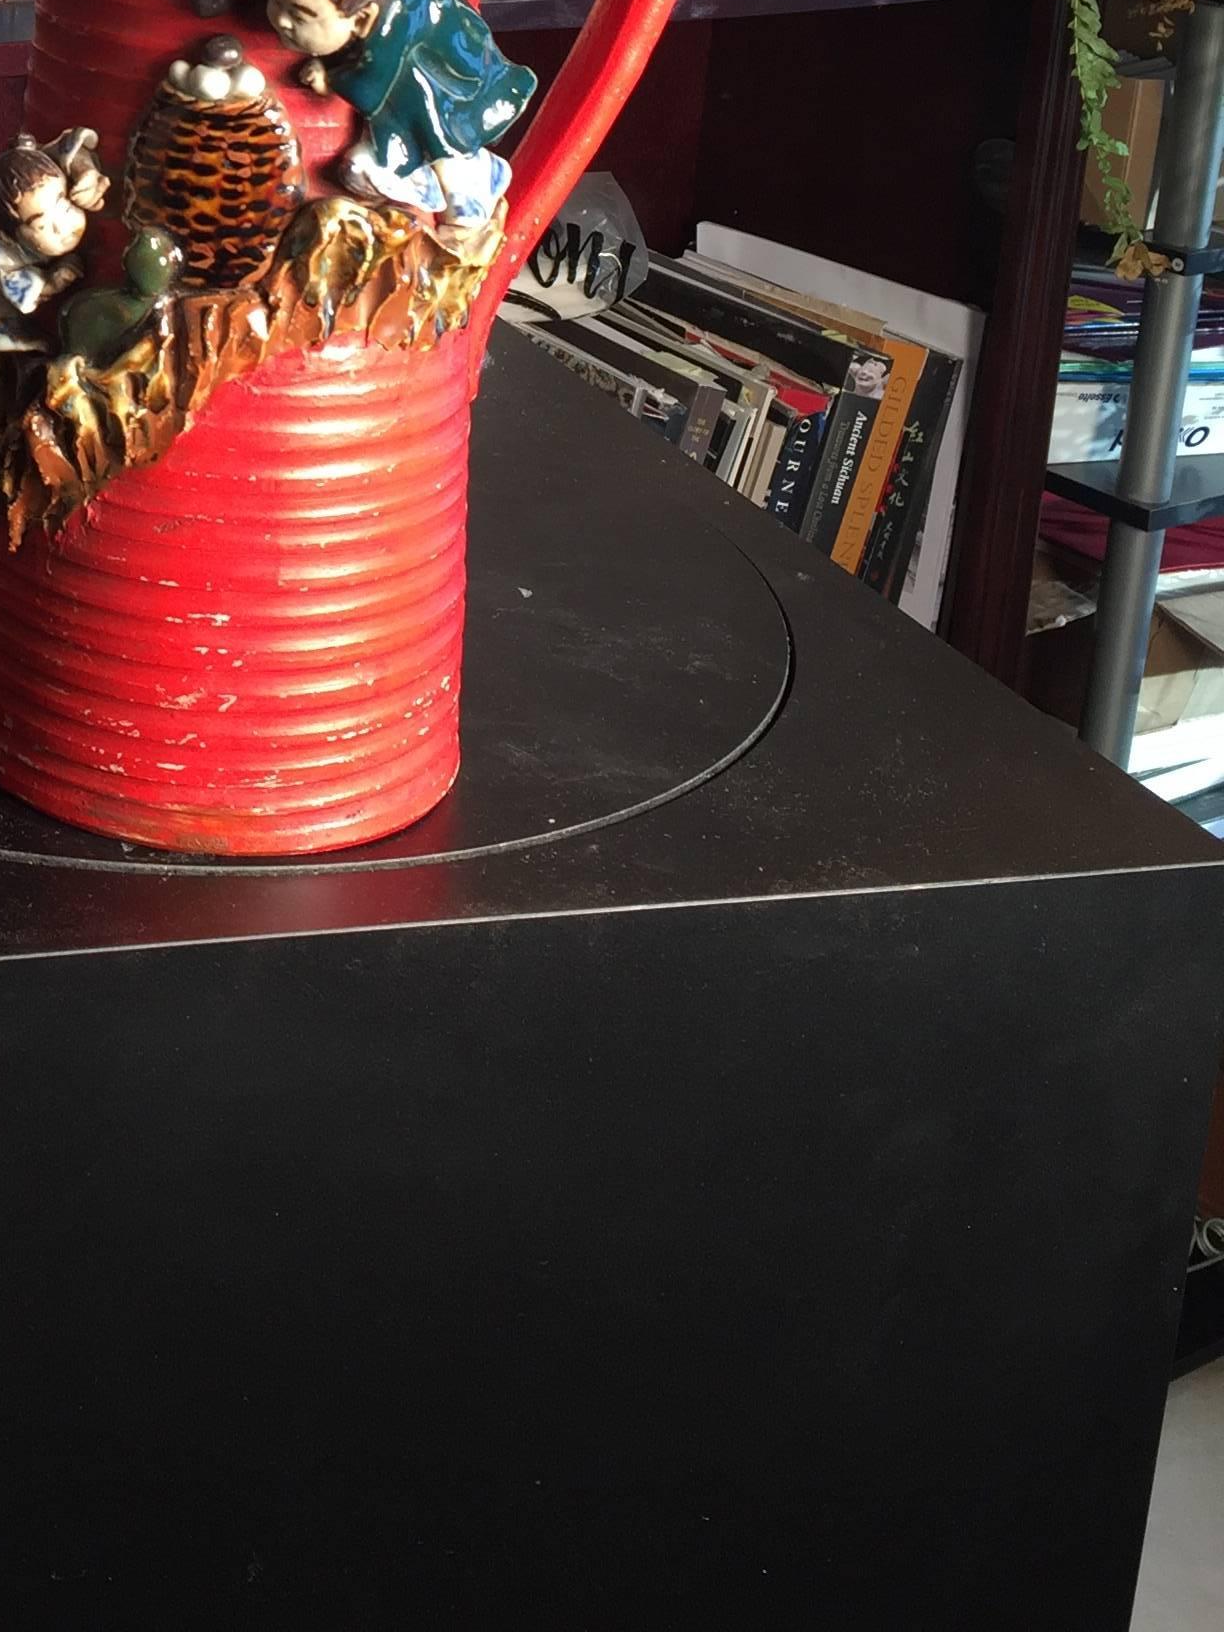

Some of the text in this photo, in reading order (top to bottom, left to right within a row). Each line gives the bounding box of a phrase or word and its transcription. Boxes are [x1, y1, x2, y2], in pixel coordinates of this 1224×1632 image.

[831, 410, 868, 505] Ancient Sichuan
[838, 376, 907, 566] GILDED SPLEN
